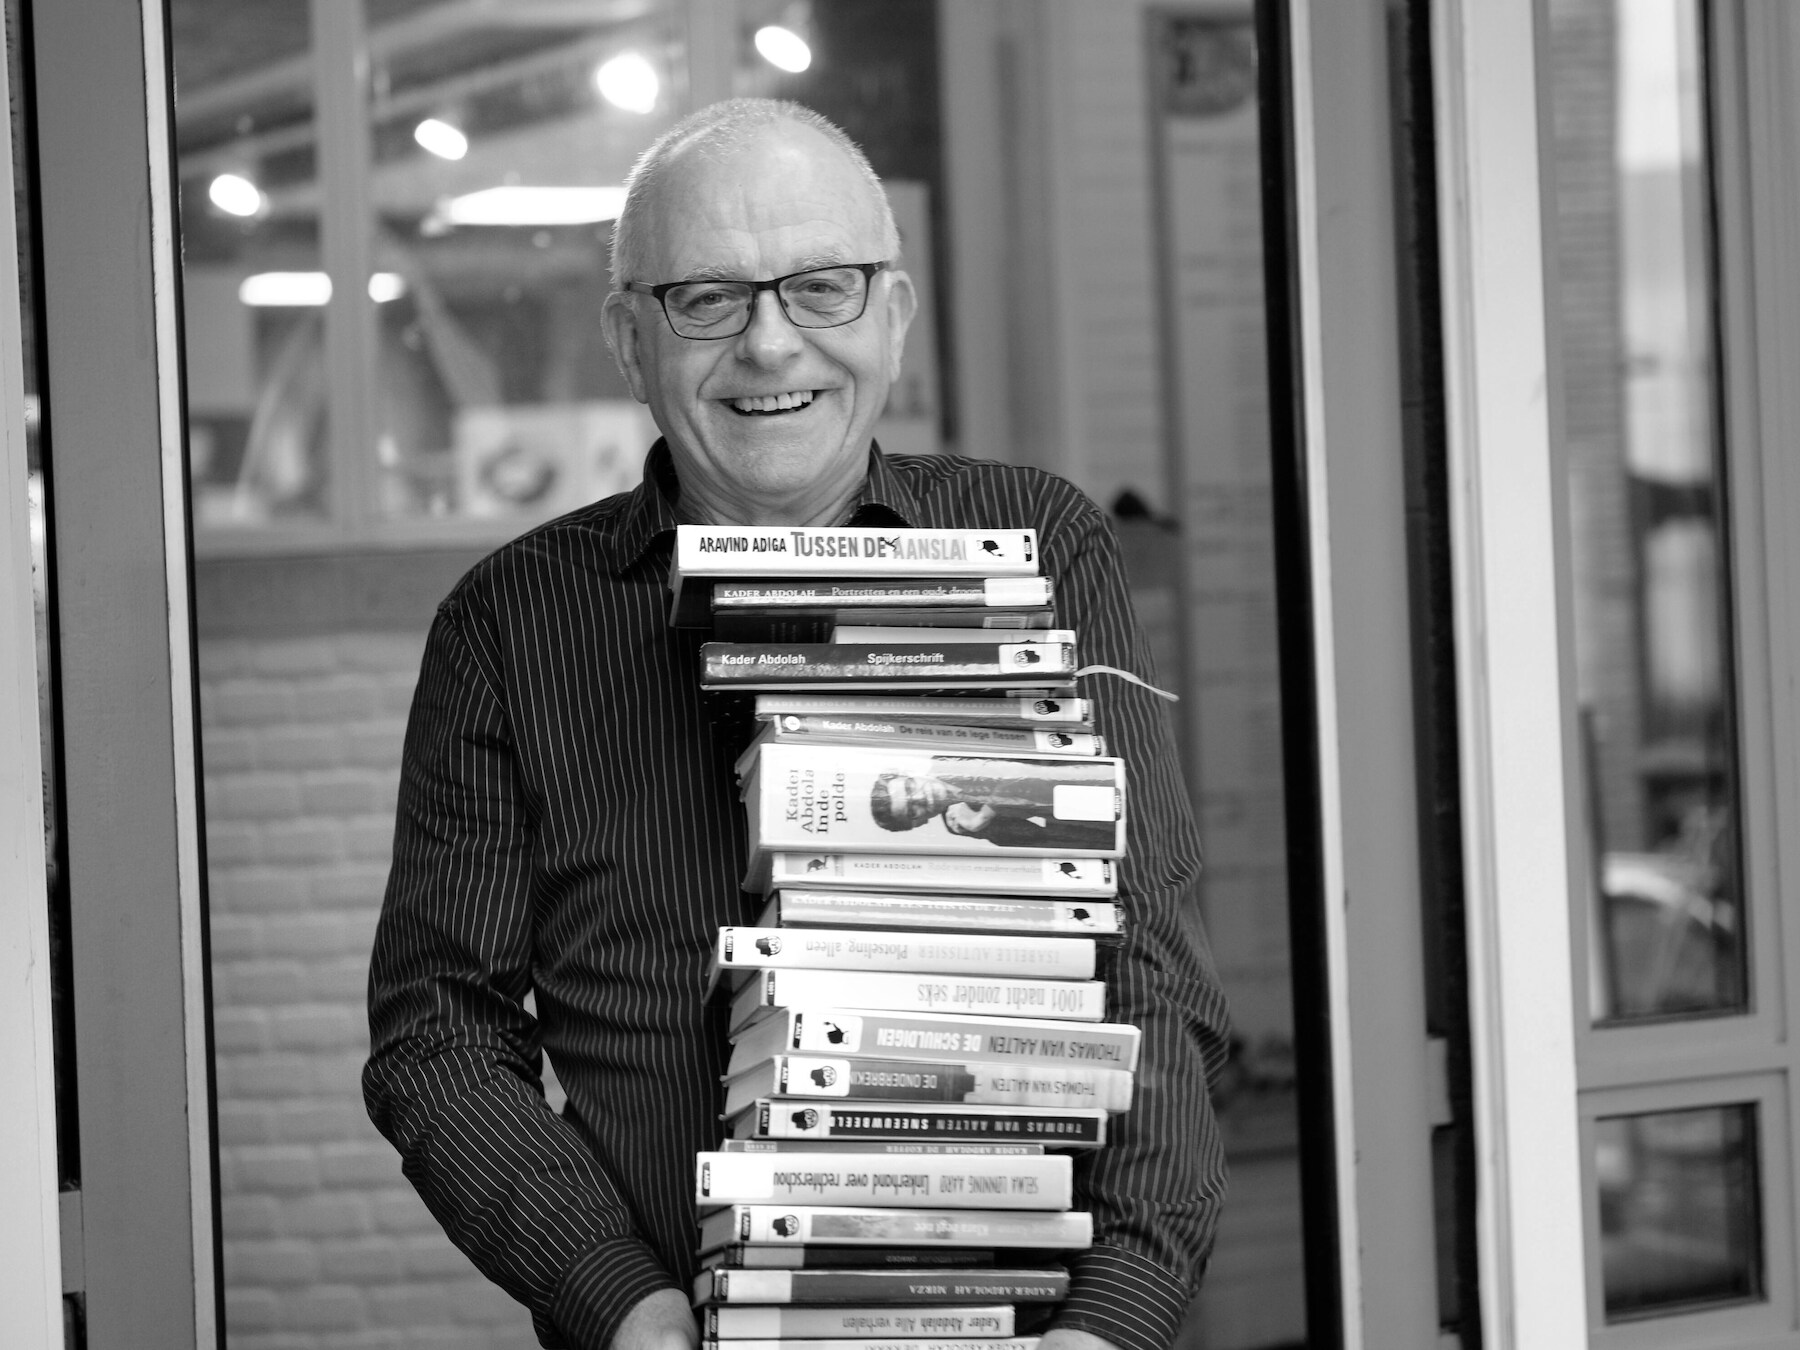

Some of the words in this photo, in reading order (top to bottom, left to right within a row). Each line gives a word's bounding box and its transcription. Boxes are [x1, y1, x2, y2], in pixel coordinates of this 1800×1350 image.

[699, 537, 749, 553] ARAVIND
[752, 537, 787, 553] ADIGA
[790, 531, 859, 558] TUSSEN
[863, 537, 887, 558] DE
[724, 589, 762, 598] KADER
[765, 589, 816, 598] ABDOLAH
[831, 586, 886, 597] Portretten
[721, 654, 756, 666] Kader
[758, 654, 807, 666] Abdolah
[867, 652, 945, 667] Spijkerschrift
[822, 720, 852, 731] Kader
[854, 722, 895, 733] Abdolah
[899, 725, 913, 734] De
[915, 726, 933, 735] reis
[936, 728, 953, 737] van
[956, 728, 968, 738] de
[970, 730, 990, 741] lege
[816, 790, 829, 811] de
[816, 814, 829, 834] In
[806, 941, 842, 958] alleen
[919, 945, 990, 961] AUTISSIER
[995, 948, 1060, 965] ISABELLE
[917, 984, 949, 1007] seks
[951, 985, 1001, 1009] zonder
[1006, 986, 1045, 1010] nacht
[1050, 988, 1084, 1012] 1001
[876, 1027, 961, 1051] SCHULDIGEN
[963, 1033, 982, 1052] DE
[987, 1036, 1039, 1056] AALTEN
[1040, 1039, 1066, 1058] VAN
[1069, 1042, 1121, 1063] THOMAS
[922, 1073, 939, 1090] DE
[990, 1078, 1030, 1094] AALTEN
[1031, 1080, 1053, 1095] VAN
[1054, 1080, 1096, 1096] THOMAS
[935, 1118, 988, 1132] AALTEN
[994, 1119, 1020, 1132] VAN
[1026, 1120, 1082, 1134] THOMAS
[844, 1173, 869, 1187] over
[872, 1174, 930, 1196] Linkerhand
[1010, 1175, 1040, 1195] SELMA
[908, 1285, 948, 1295] MIRZA
[954, 1286, 1013, 1296] ABDOLAH
[1014, 1287, 1057, 1297] KADER
[843, 1318, 891, 1334] verhalen
[894, 1318, 916, 1333] Alle
[920, 1318, 964, 1333] Abdolah
[968, 1318, 1000, 1333] Kader
